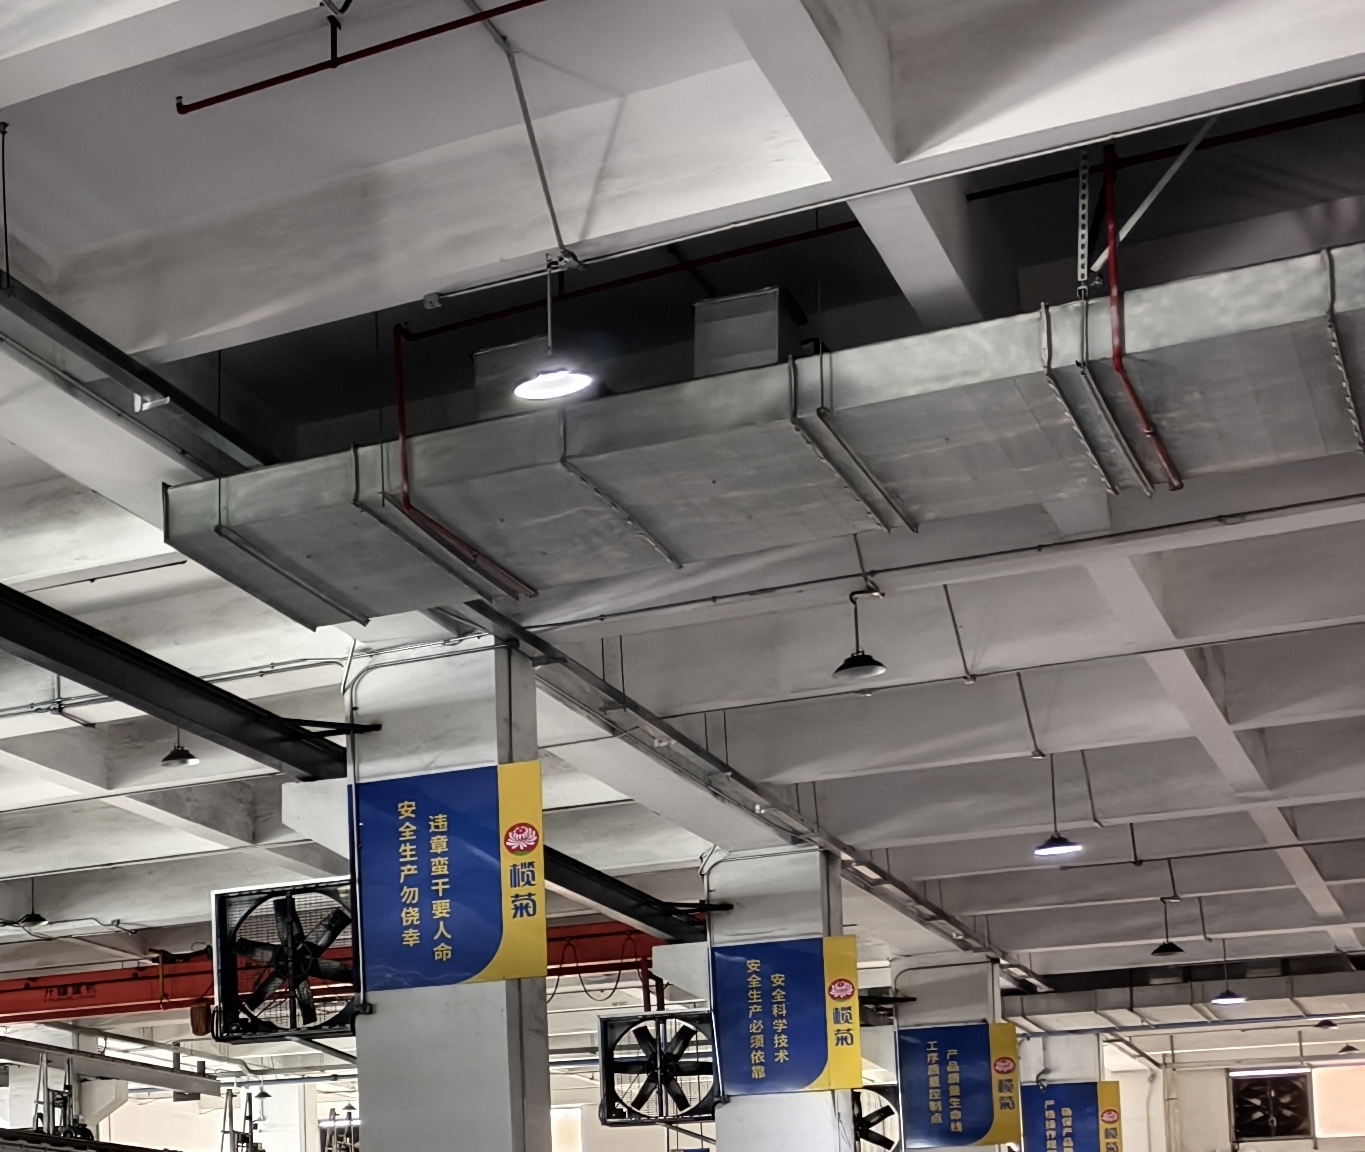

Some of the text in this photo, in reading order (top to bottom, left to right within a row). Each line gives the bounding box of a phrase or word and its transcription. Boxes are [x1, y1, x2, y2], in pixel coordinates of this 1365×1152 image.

[397, 800, 421, 947] 安全生产勿侥幸
[428, 813, 453, 962] 违章蛮干要人命
[509, 860, 537, 919] 榄菊
[746, 958, 767, 1080] 安全生产必须依靠
[770, 973, 790, 1064] 安全科学技术
